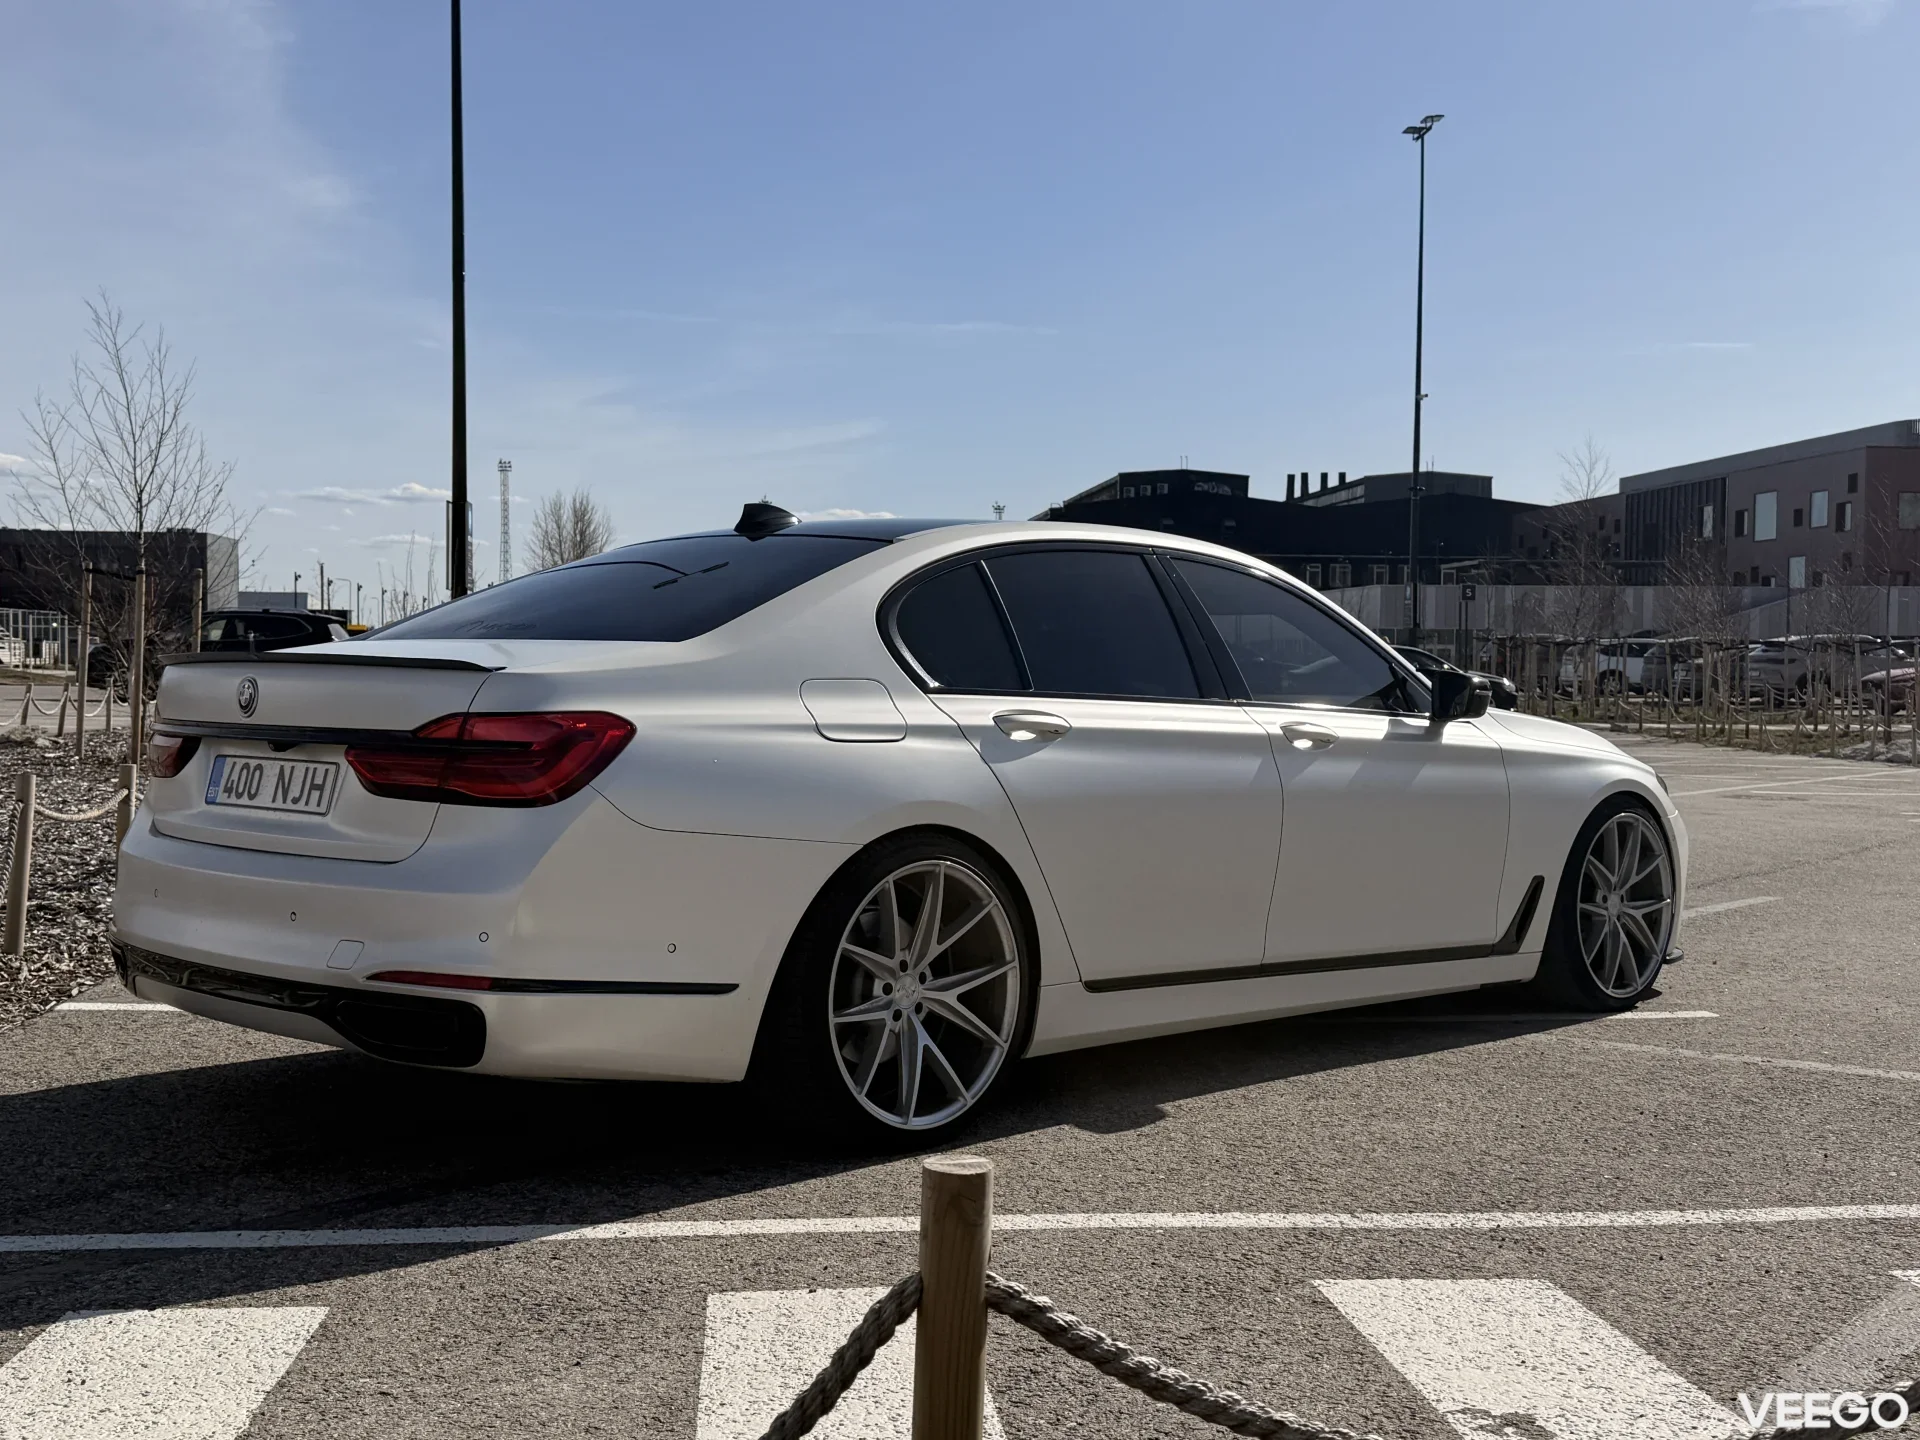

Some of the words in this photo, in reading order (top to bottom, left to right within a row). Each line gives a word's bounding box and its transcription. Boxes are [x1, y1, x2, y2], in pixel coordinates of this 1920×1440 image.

[207, 786, 219, 797] EST
[222, 761, 264, 801] 400
[271, 765, 330, 808] NJH
